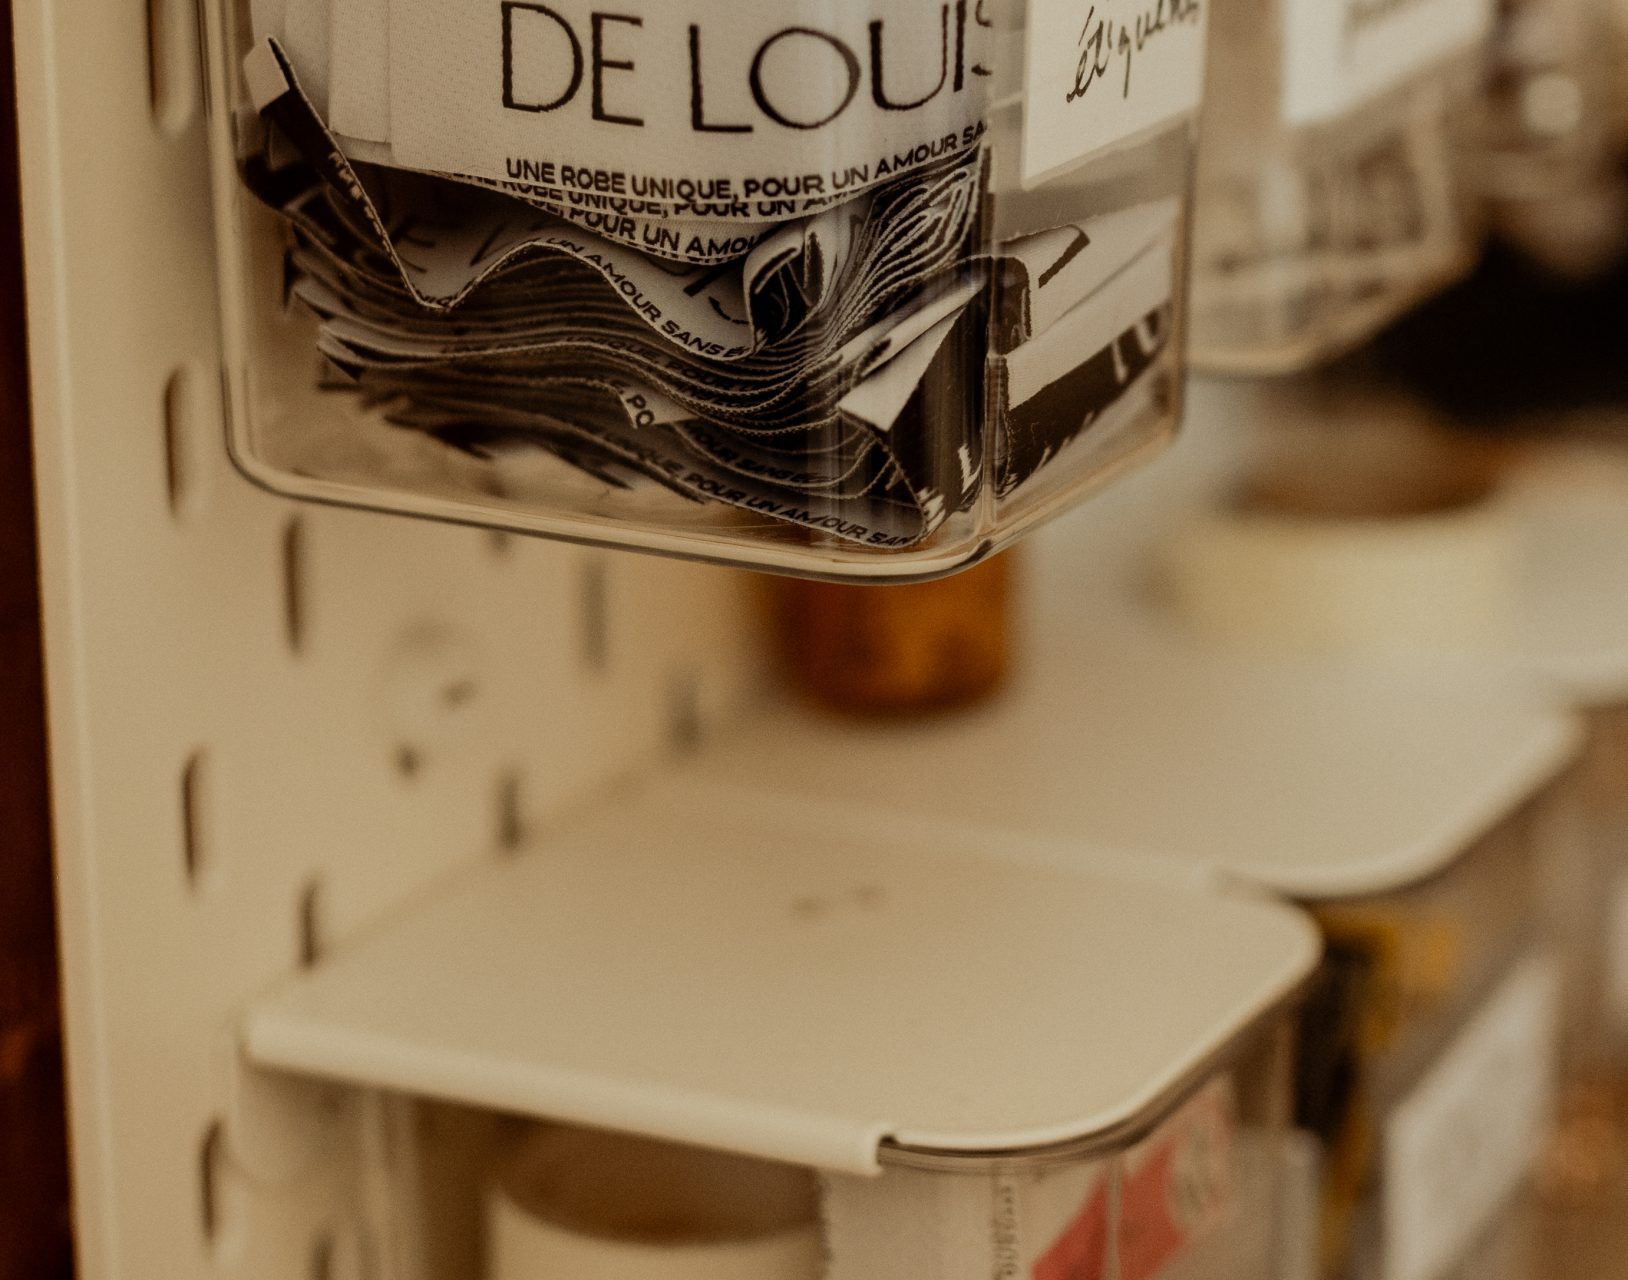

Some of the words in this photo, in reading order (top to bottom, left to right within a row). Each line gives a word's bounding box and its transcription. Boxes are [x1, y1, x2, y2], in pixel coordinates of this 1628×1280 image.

[500, 0, 644, 127] DE
[505, 157, 555, 185] UNE
[560, 165, 627, 195] ROBE
[630, 174, 739, 203] UNIQUE,
[743, 174, 825, 199] POUR
[831, 164, 869, 190] UN
[874, 132, 959, 180] AMOUR
[642, 226, 680, 252] UN
[583, 252, 662, 322] AMOUR
